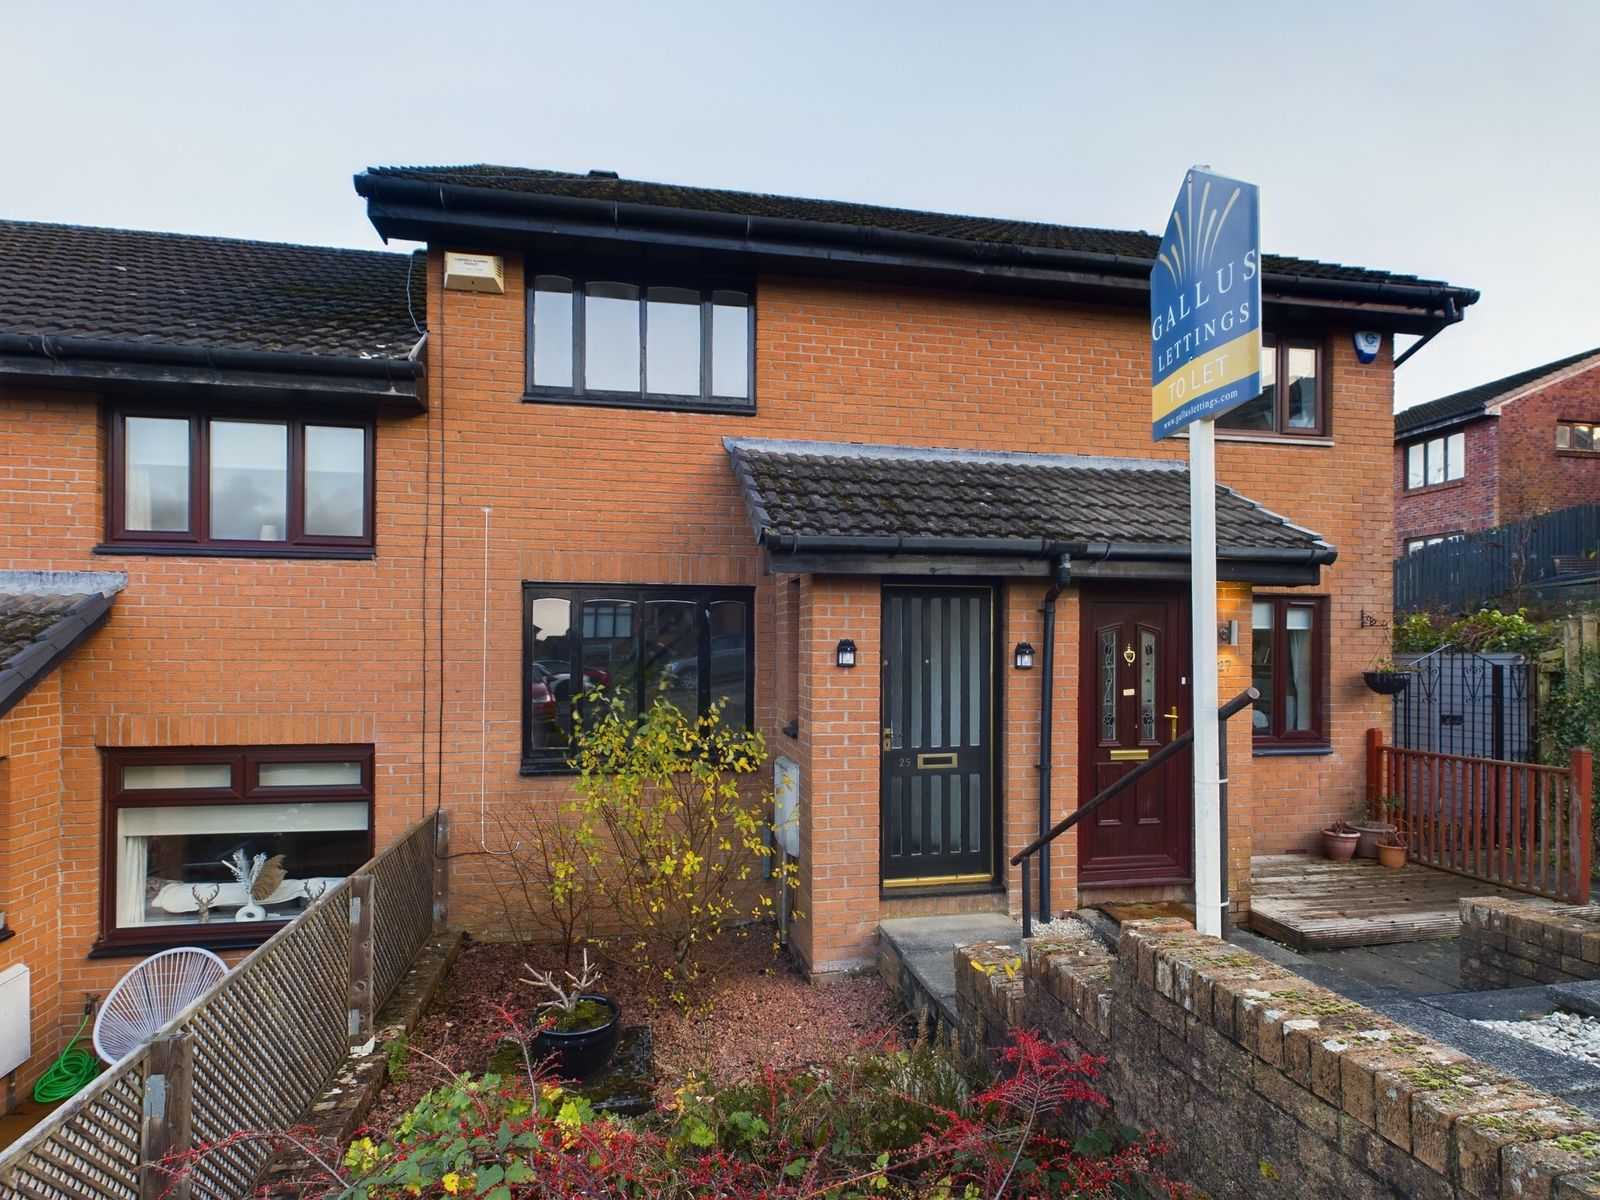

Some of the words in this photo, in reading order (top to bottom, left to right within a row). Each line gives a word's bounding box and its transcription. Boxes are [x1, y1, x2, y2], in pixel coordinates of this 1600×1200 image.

[1152, 248, 1256, 341] GALLUS
[1158, 302, 1250, 373] LETTINGS
[1168, 376, 1185, 403] TO
[1191, 353, 1229, 390] LET
[1163, 389, 1238, 429] www.galluslettings.com
